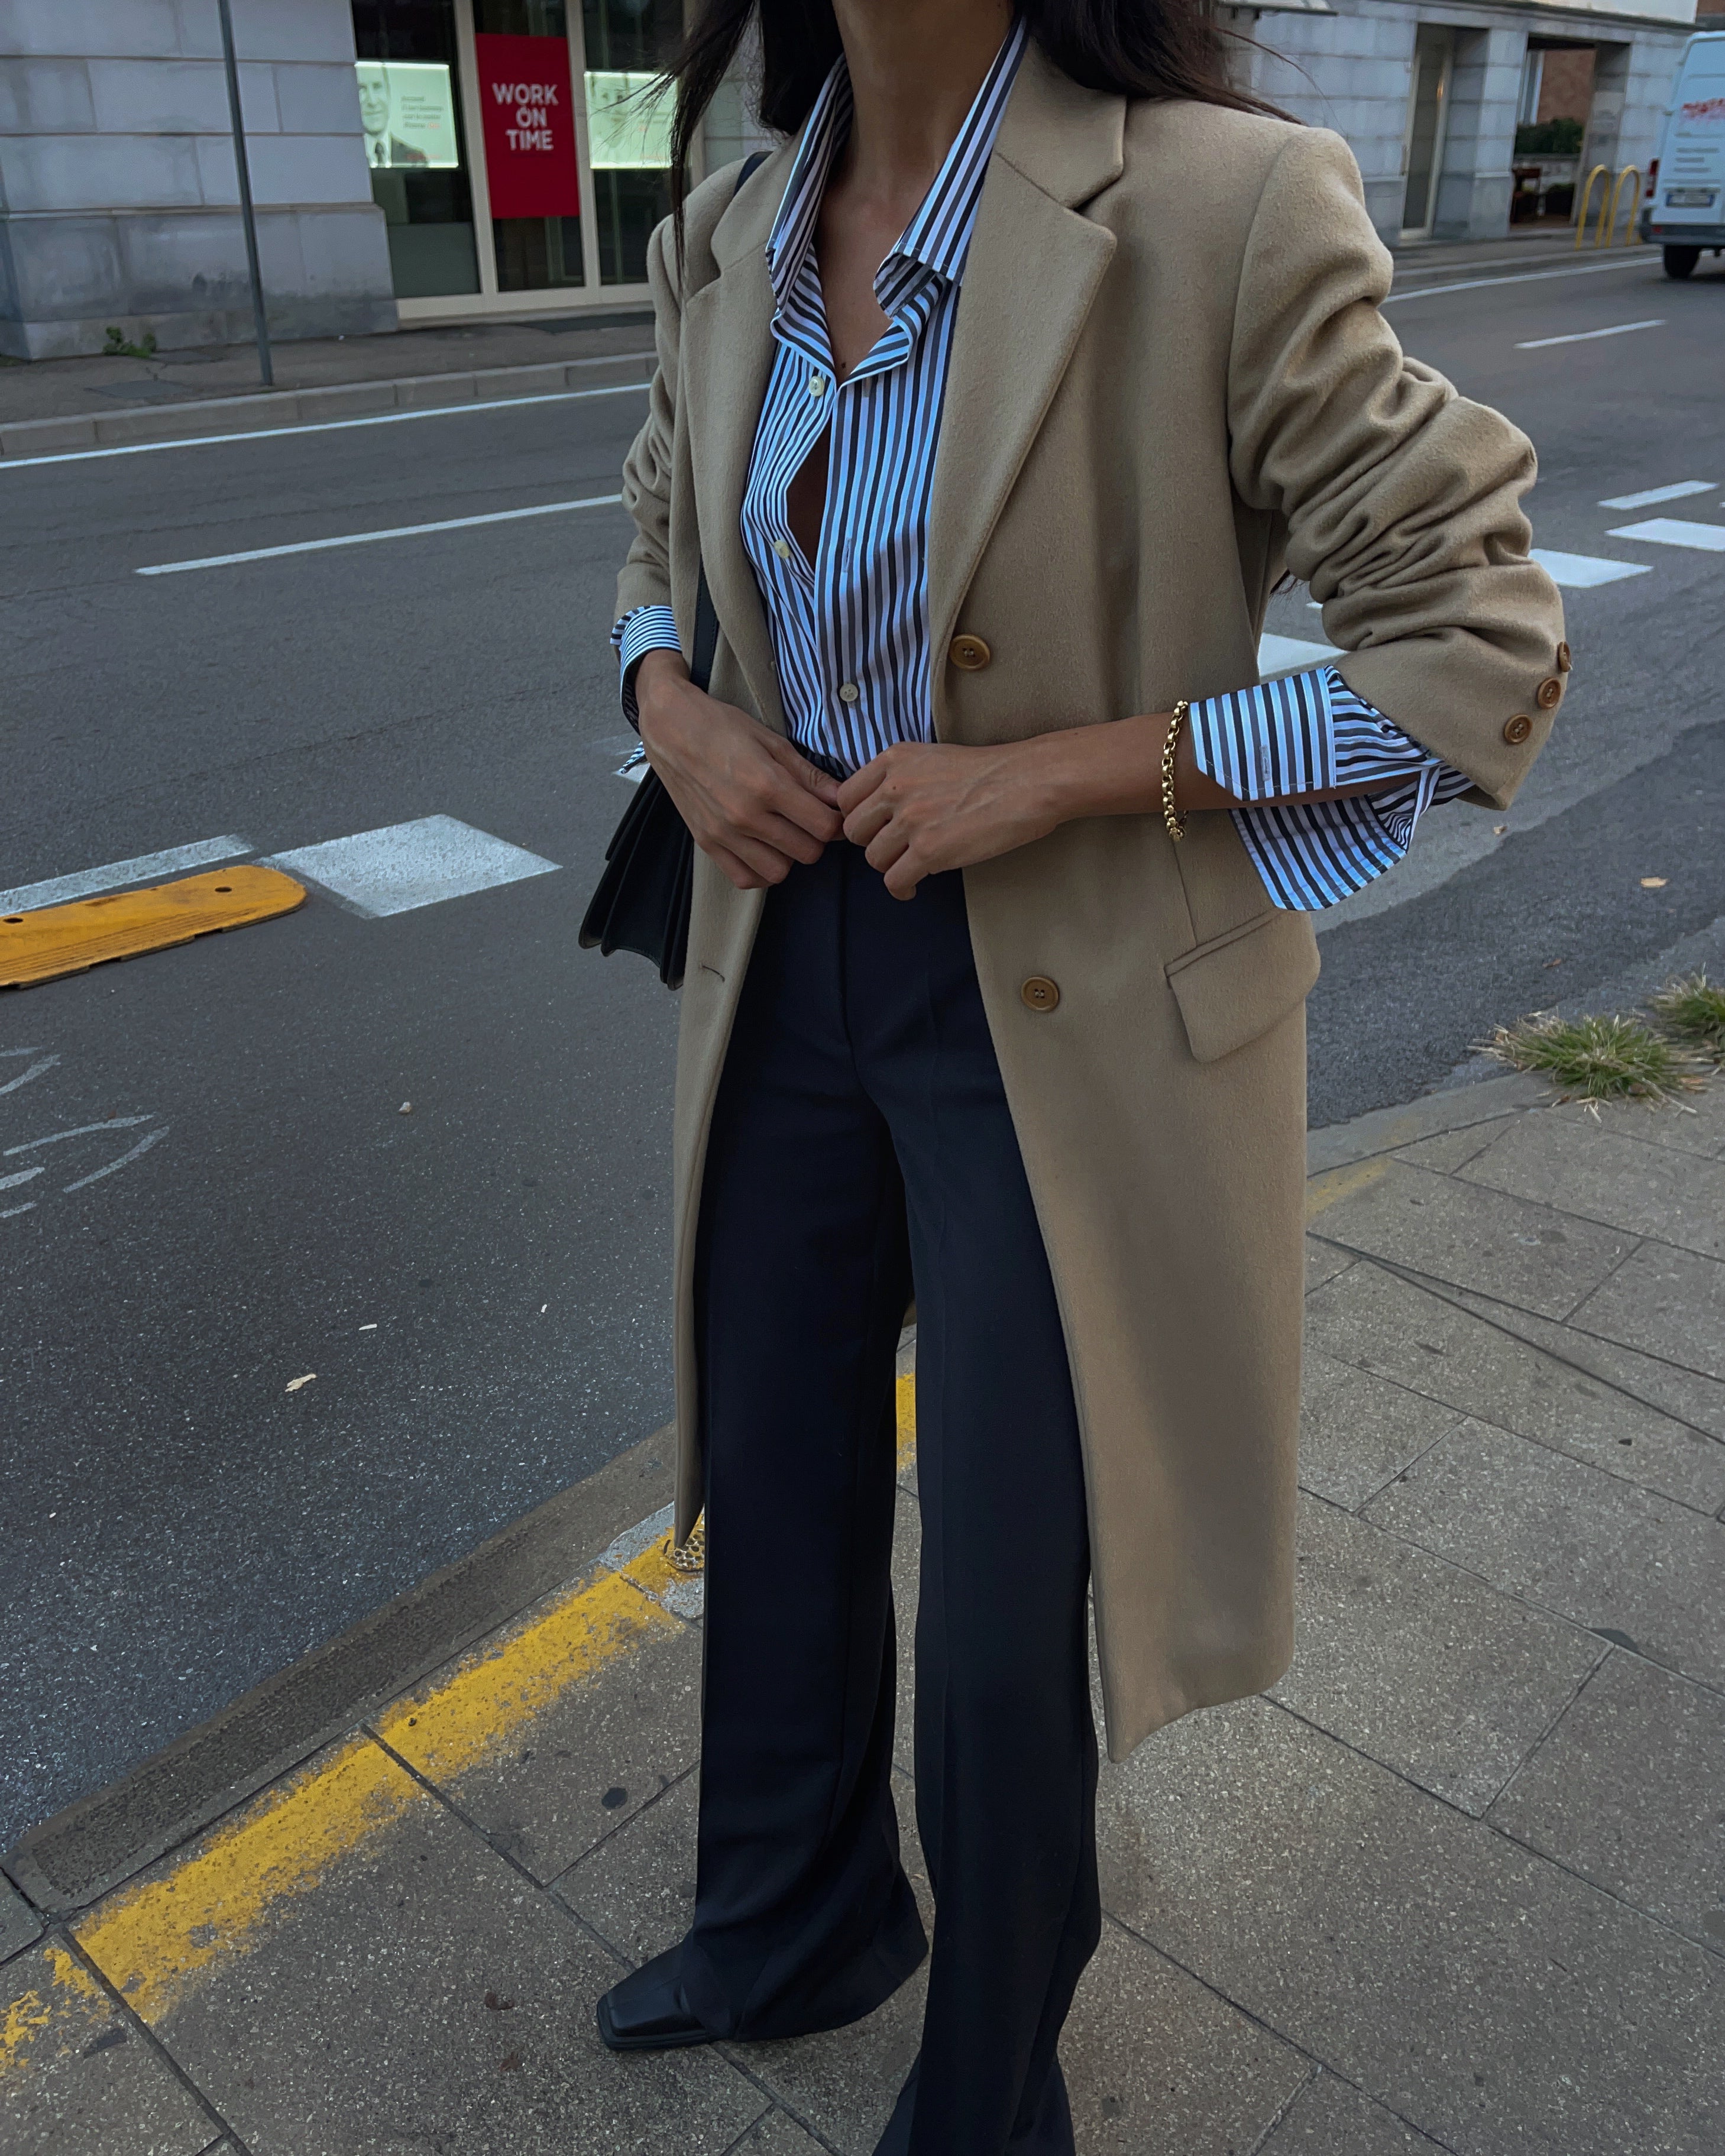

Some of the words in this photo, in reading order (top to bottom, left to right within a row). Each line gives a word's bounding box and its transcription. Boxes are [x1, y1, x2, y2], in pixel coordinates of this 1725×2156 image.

[492, 83, 559, 105] WORK
[516, 107, 547, 128] ON
[505, 129, 554, 150] TIME
